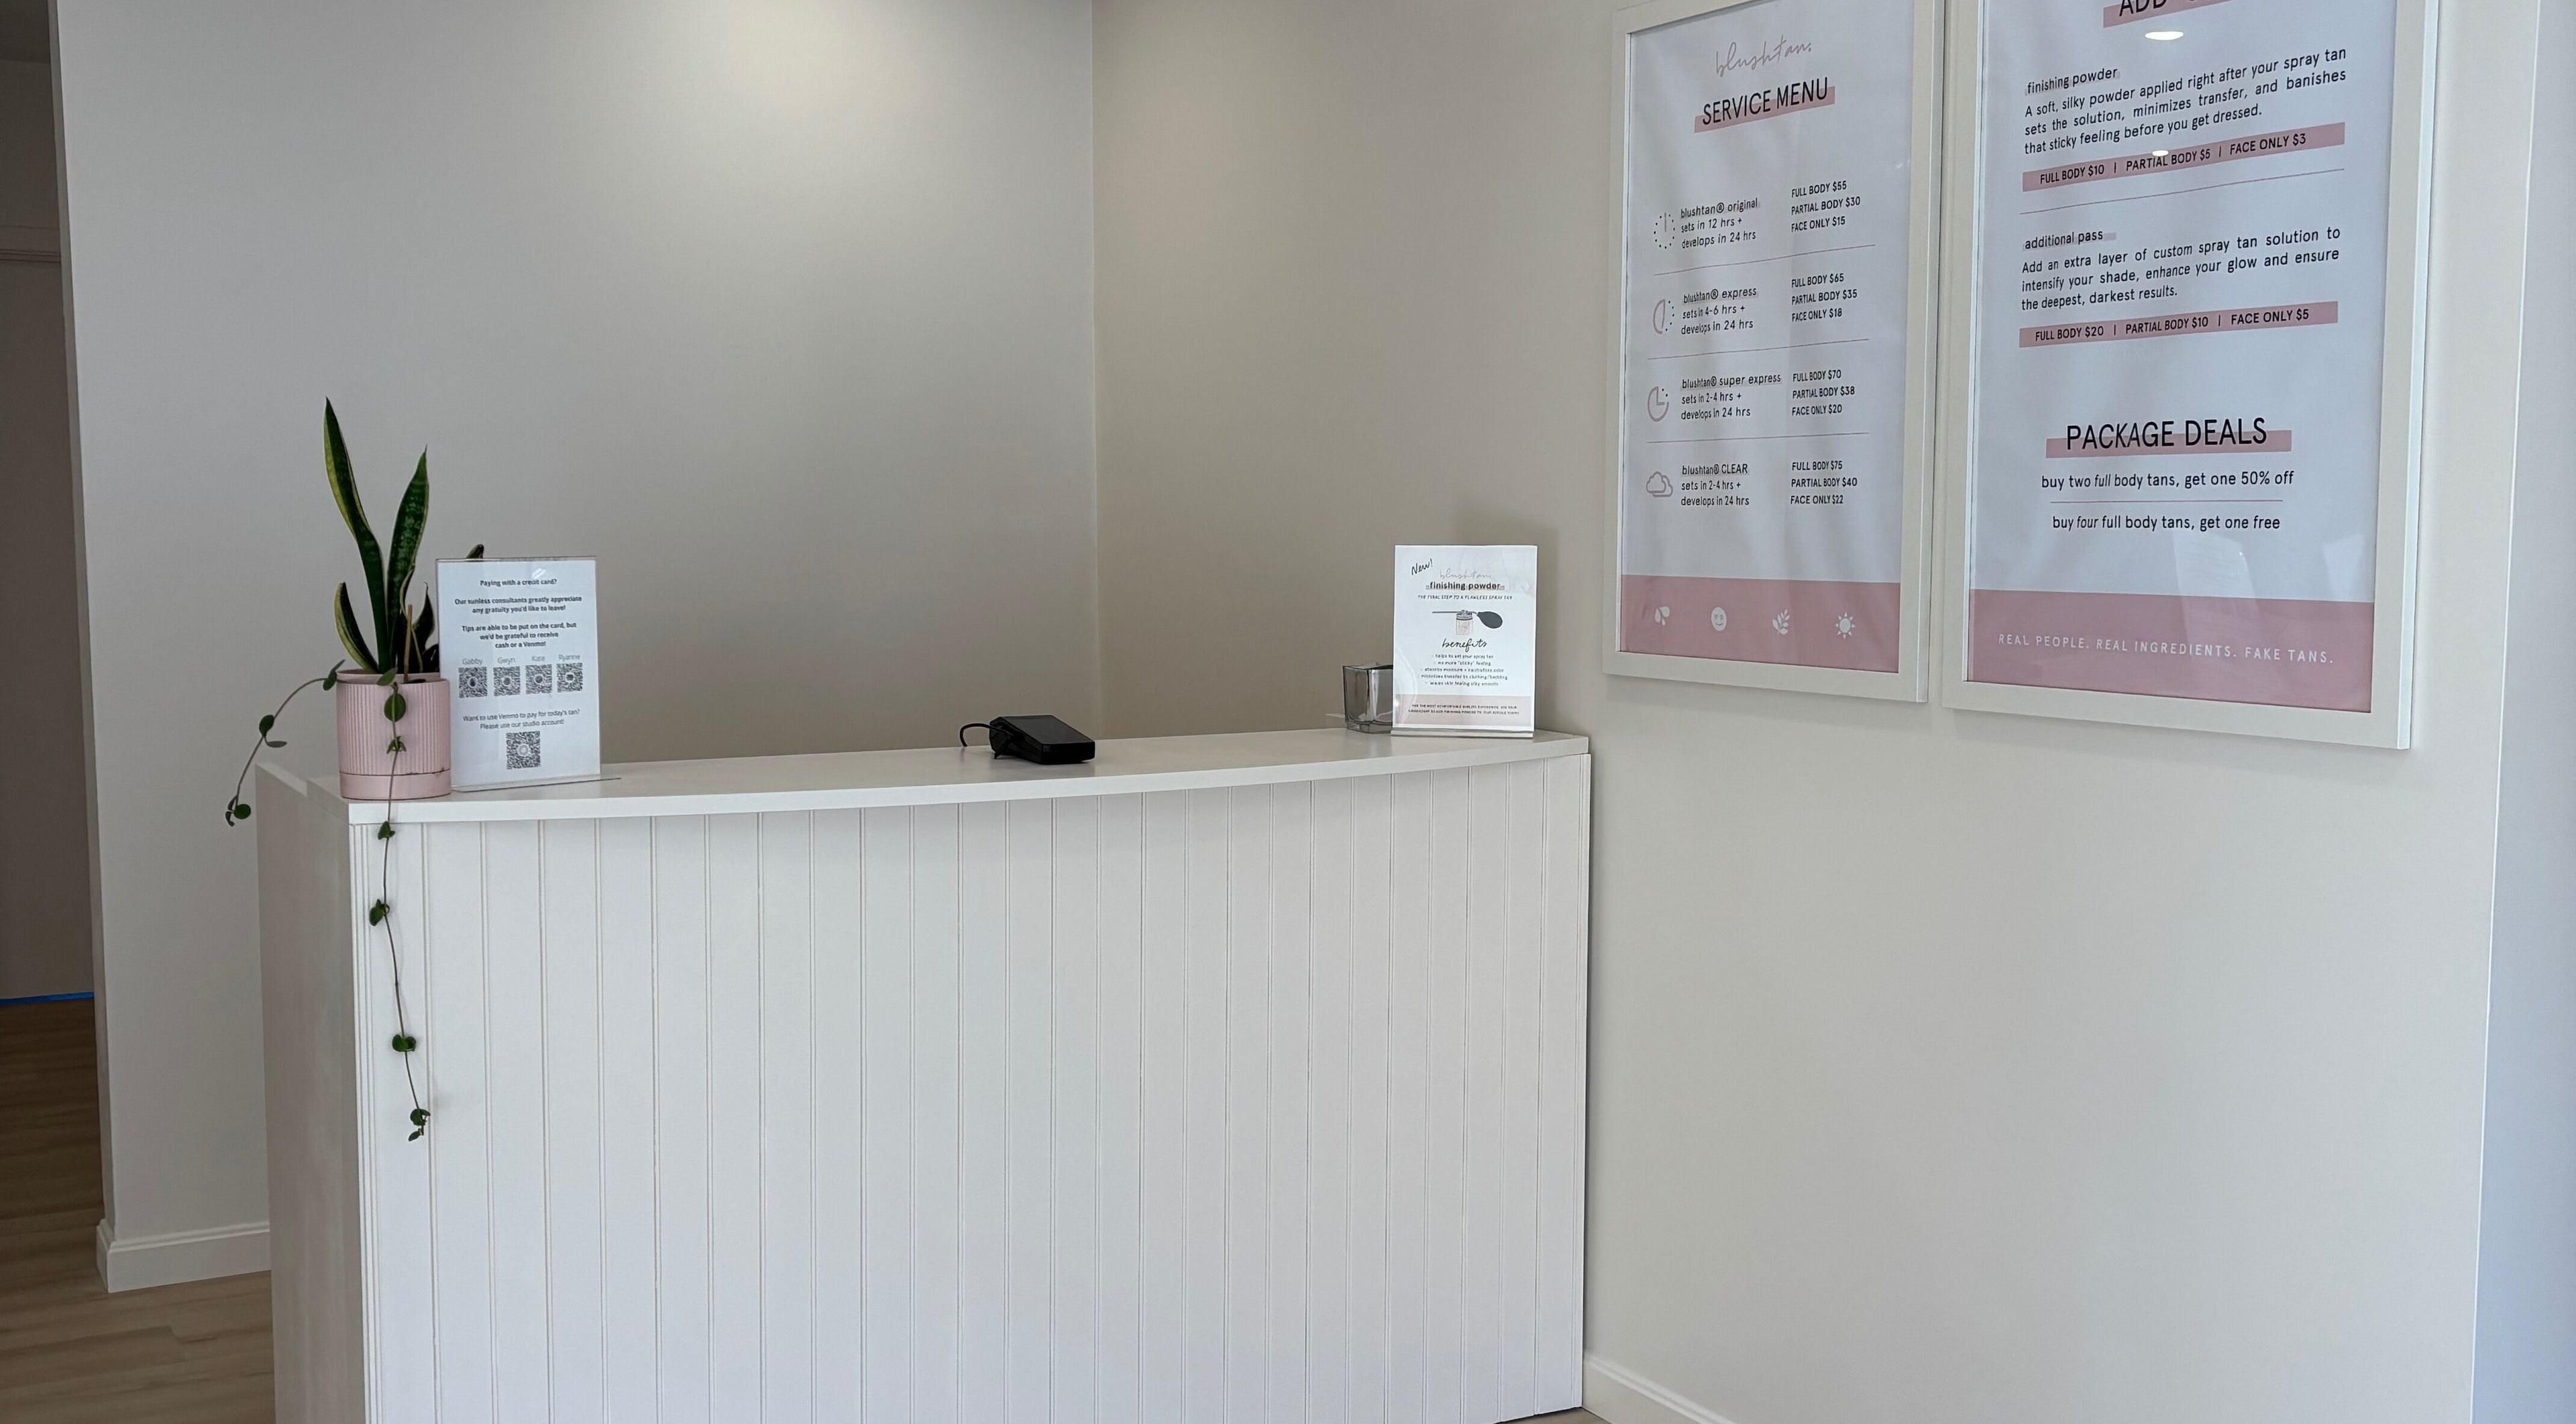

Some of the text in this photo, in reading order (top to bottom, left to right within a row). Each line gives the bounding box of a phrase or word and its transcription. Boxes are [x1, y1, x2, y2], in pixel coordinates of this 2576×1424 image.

[2025, 49, 2345, 117] A soft, silky powder applied right after your spray tan
[2027, 68, 2118, 93] finishing powder
[1702, 76, 1827, 125] SERVICE MENU
[2040, 133, 2306, 184] FULL BODY $10 PARTIAL BODY $5 FACE ONLY $3
[1791, 180, 1847, 198] FULL BODY $55
[1727, 197, 1757, 213] original
[1791, 197, 1860, 215] PARTIAL BODY $30
[1681, 222, 1695, 233] sets
[1697, 221, 1705, 229] in
[1709, 218, 1717, 228] 12
[1720, 217, 1734, 227] hrs
[1791, 215, 1845, 232] FACE ONLY $15
[1681, 230, 1756, 248] develops in 24 hrs
[2025, 231, 2102, 249] additional pass
[2022, 226, 2340, 273] Add an extra layer of custom spray tan solution to
[1721, 288, 1756, 300] express
[1719, 376, 1745, 388] super
[1748, 374, 1780, 385] express
[1792, 369, 1841, 382] FULL BODY $70
[1792, 386, 1855, 398] PARTIAL BODY $38
[1792, 404, 1842, 415] FACE ONLY $20
[2067, 417, 2267, 449] PACKAGE DEALS
[1721, 463, 1748, 474] CLEAR
[1792, 460, 1842, 471] FULL BODY $75
[1791, 477, 1857, 487] PARTIAL BODY $40
[2041, 470, 2294, 491] buy two full body tans, get one 50% off
[1790, 494, 1843, 504] FACE ONLY $22
[1411, 558, 1433, 576] New!
[1430, 582, 1500, 590] finishing powder
[1442, 638, 1487, 652] benefits
[1996, 634, 2332, 663] REAL PEOPLE. REAL INGREDIENTS. FAKE TANS.
